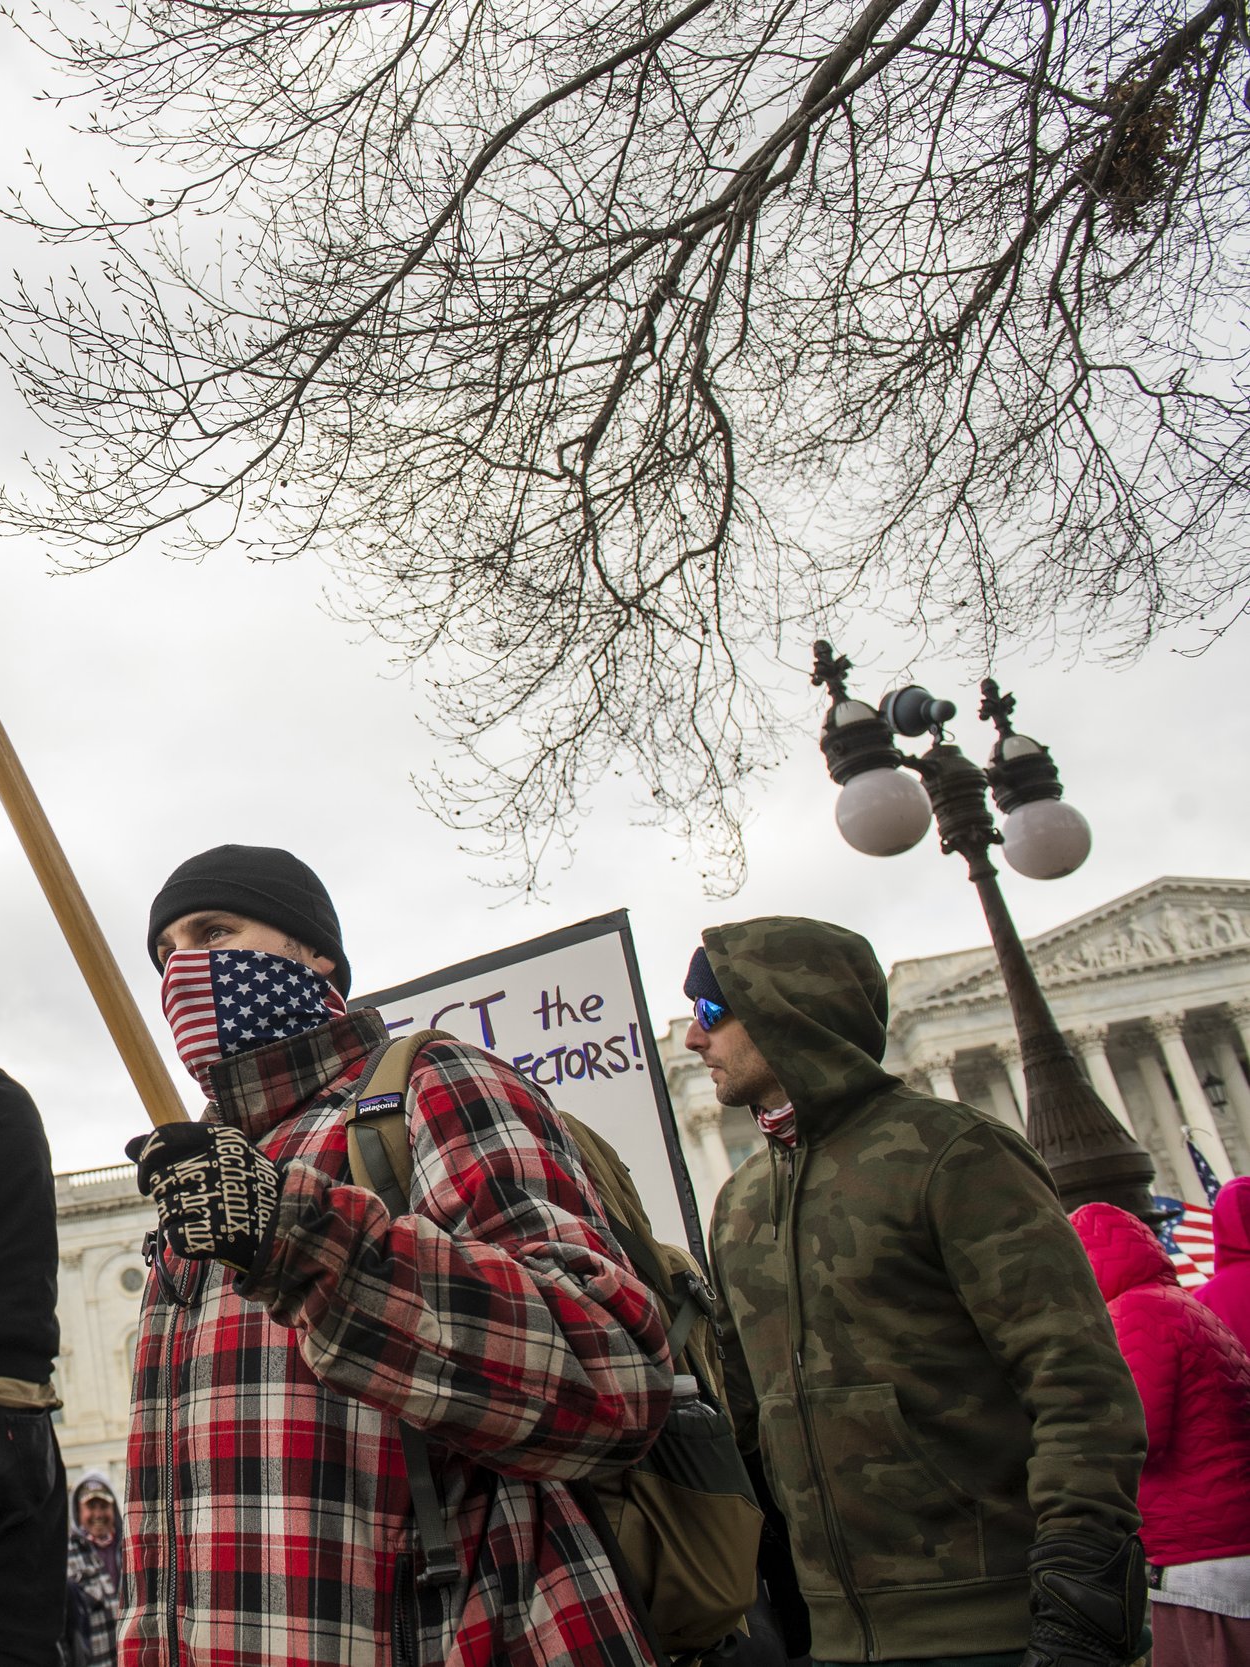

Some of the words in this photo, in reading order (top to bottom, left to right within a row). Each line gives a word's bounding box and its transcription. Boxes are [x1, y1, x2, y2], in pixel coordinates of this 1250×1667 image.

[533, 985, 605, 1031] the
[359, 1101, 399, 1115] patagonia
[213, 1125, 256, 1236] Mechanix
